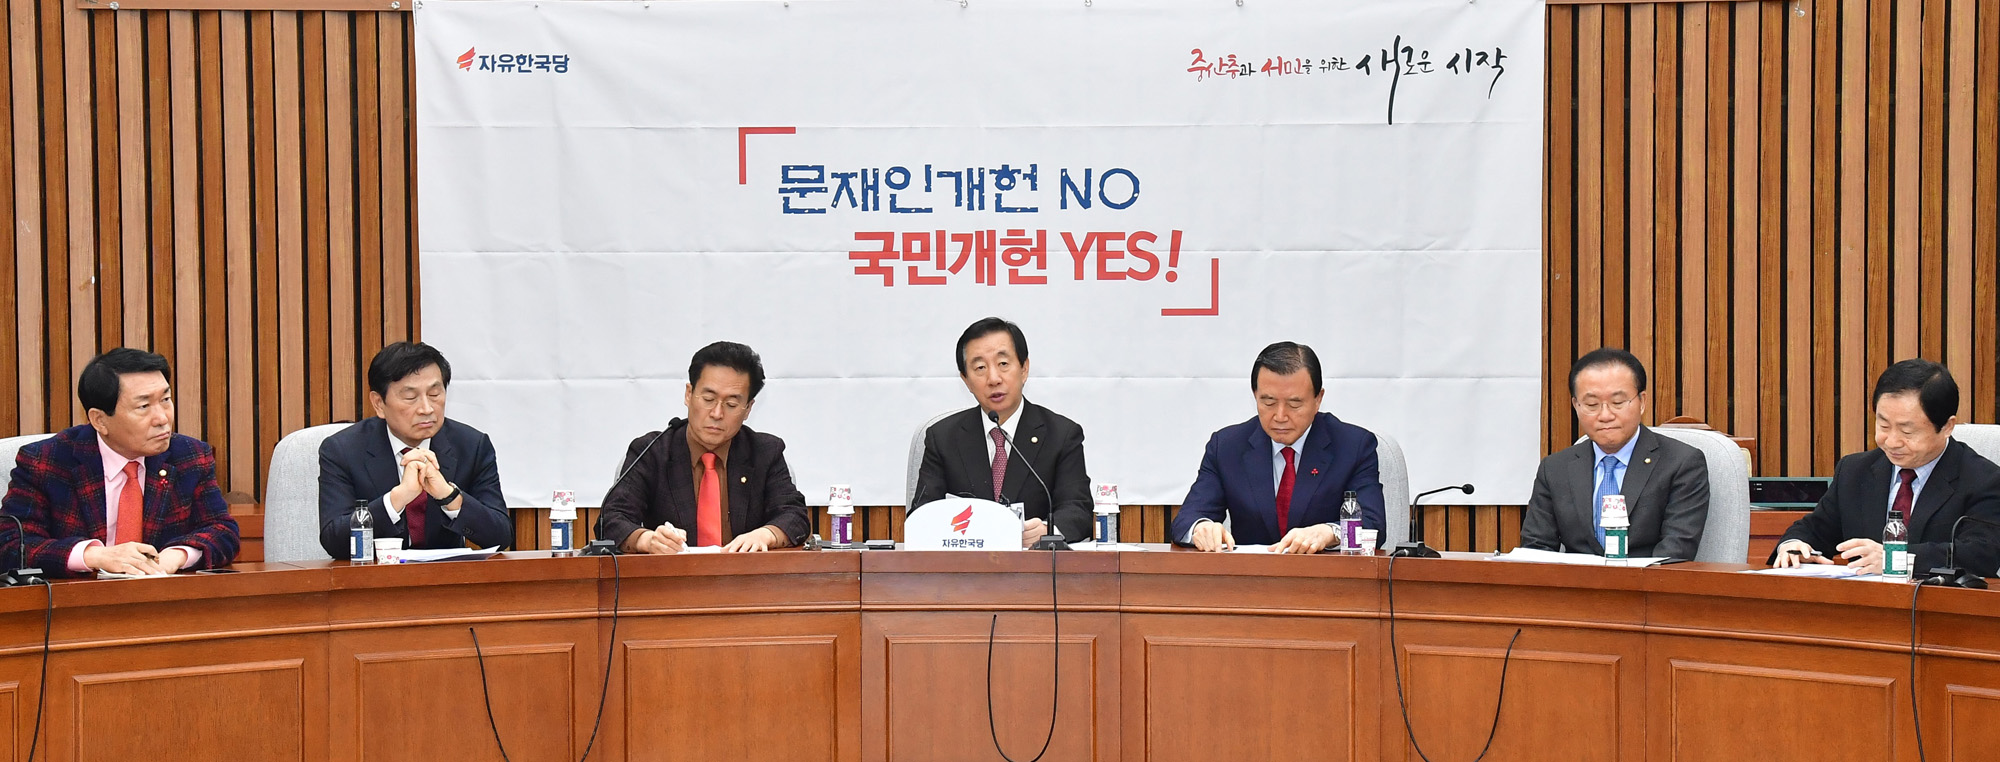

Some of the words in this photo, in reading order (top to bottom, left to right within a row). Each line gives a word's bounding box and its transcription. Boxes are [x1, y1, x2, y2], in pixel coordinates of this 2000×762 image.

[478, 53, 570, 74] 자유한국당
[1187, 48, 1257, 82] 중산층과
[1260, 55, 1313, 75] 서민을
[1318, 56, 1351, 74] 위한
[1355, 34, 1435, 126] 새로운
[1446, 47, 1508, 100] 시작
[777, 162, 1039, 215] 문재인개헌
[1059, 166, 1140, 211] NO
[848, 228, 1048, 287] 국민개헌
[1059, 229, 1184, 283] YES!
[942, 538, 984, 548] 자유한국당
